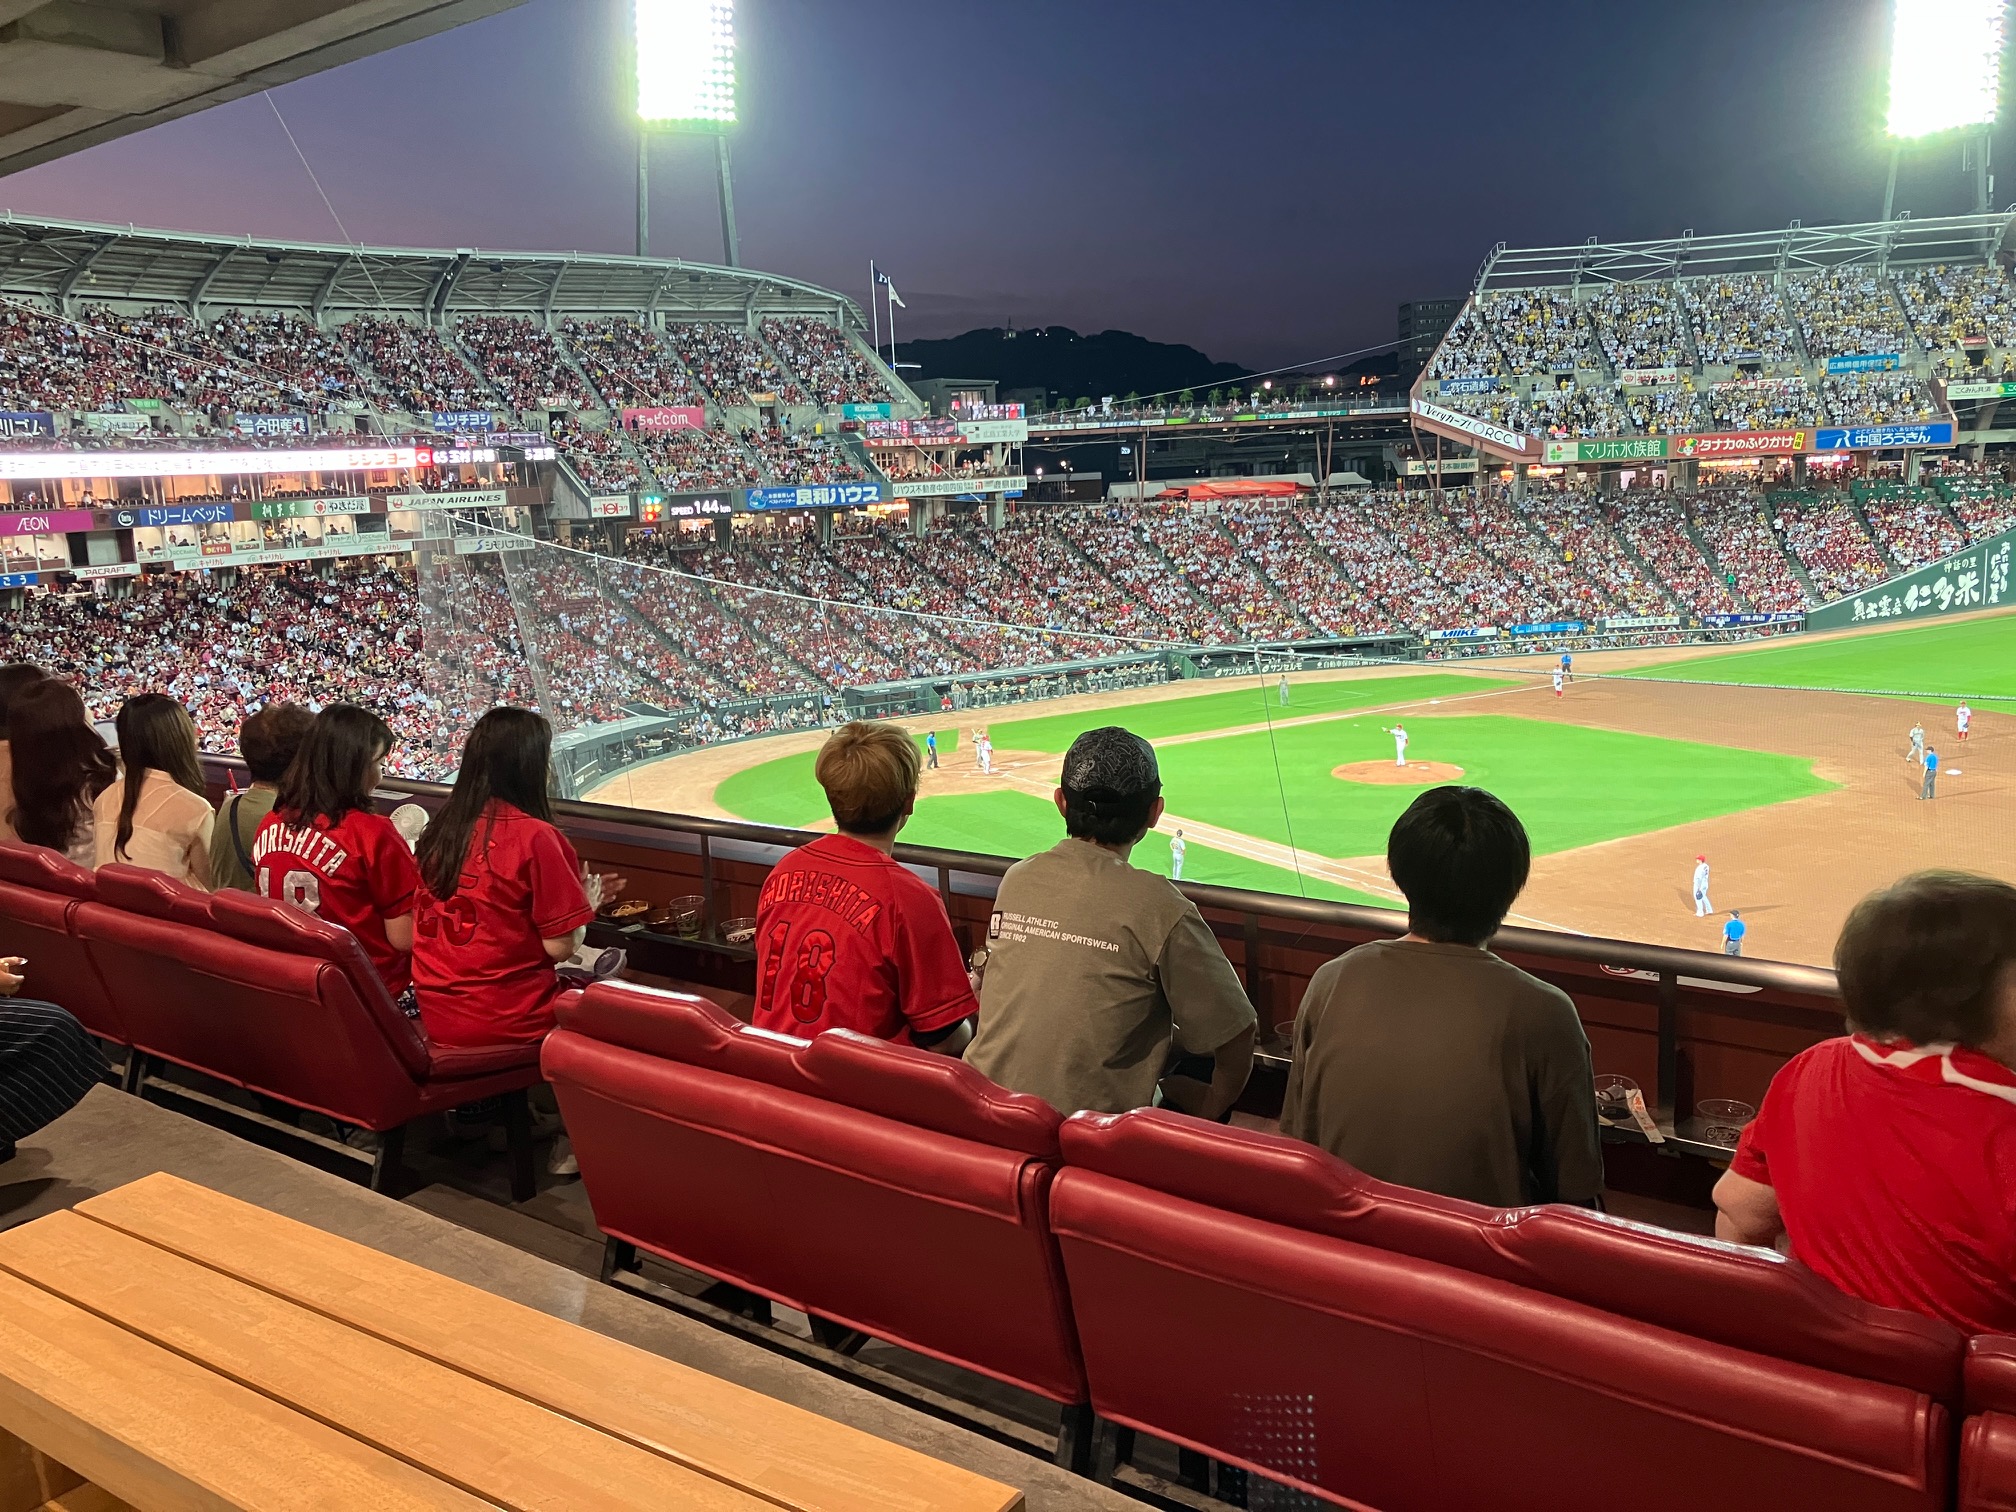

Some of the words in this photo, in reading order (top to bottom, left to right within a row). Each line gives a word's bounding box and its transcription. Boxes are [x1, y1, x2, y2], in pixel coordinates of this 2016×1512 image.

[1699, 435, 1794, 452] タナカのふりかけ
[1855, 431, 1931, 447] 中国ろうきん
[1584, 440, 1661, 459] マリホ水族館
[408, 498, 445, 506] JAPAN
[447, 494, 502, 504] AIRLINES
[796, 486, 880, 505] 良和ハウス
[148, 505, 226, 525] ドリームベッド
[670, 507, 694, 516] SPEED
[694, 499, 720, 514] 144
[720, 505, 732, 513] km
[84, 566, 127, 576] PACRAFT
[1903, 570, 1980, 612] 仁多米
[762, 869, 883, 937] MORISHITA
[1025, 917, 1059, 930] ATHLETIC
[999, 930, 1013, 940] SINCE
[1012, 933, 1027, 943] 1902
[1000, 921, 1024, 933] ORIGINAL
[1024, 926, 1061, 940] AMERICAN
[1061, 932, 1120, 953] SPORTSWEAR
[760, 920, 836, 1024] 18
